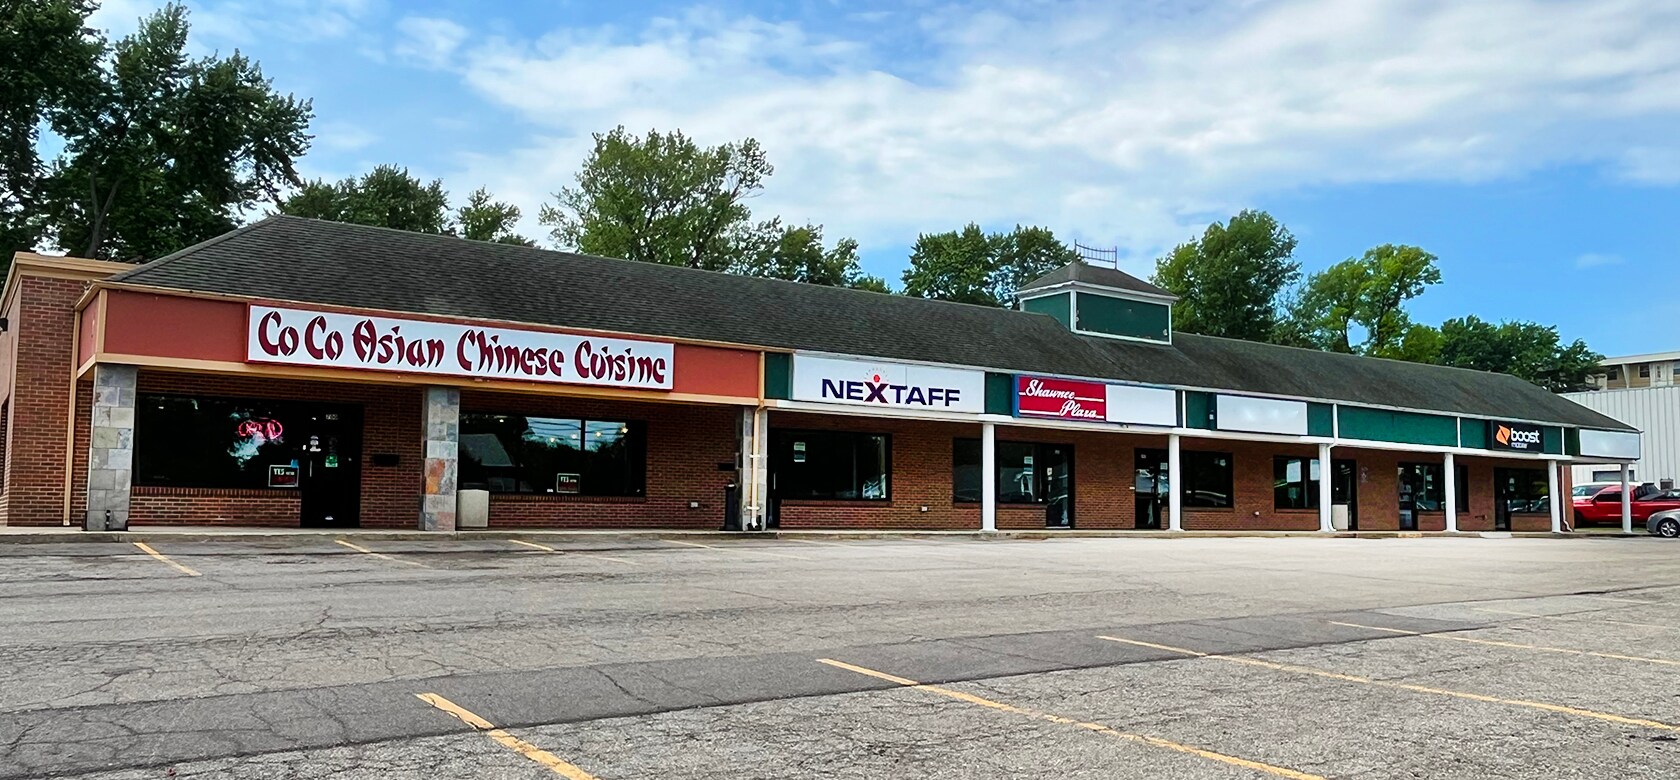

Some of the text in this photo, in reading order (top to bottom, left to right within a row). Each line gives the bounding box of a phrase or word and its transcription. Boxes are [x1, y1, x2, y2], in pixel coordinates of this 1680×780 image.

[258, 311, 667, 384] Co Co Asian Chinese Cuisine
[822, 378, 960, 407] NEXTAFF
[1026, 379, 1075, 399] Shawnee
[1059, 400, 1097, 418] Plaza
[1511, 428, 1540, 443] boost
